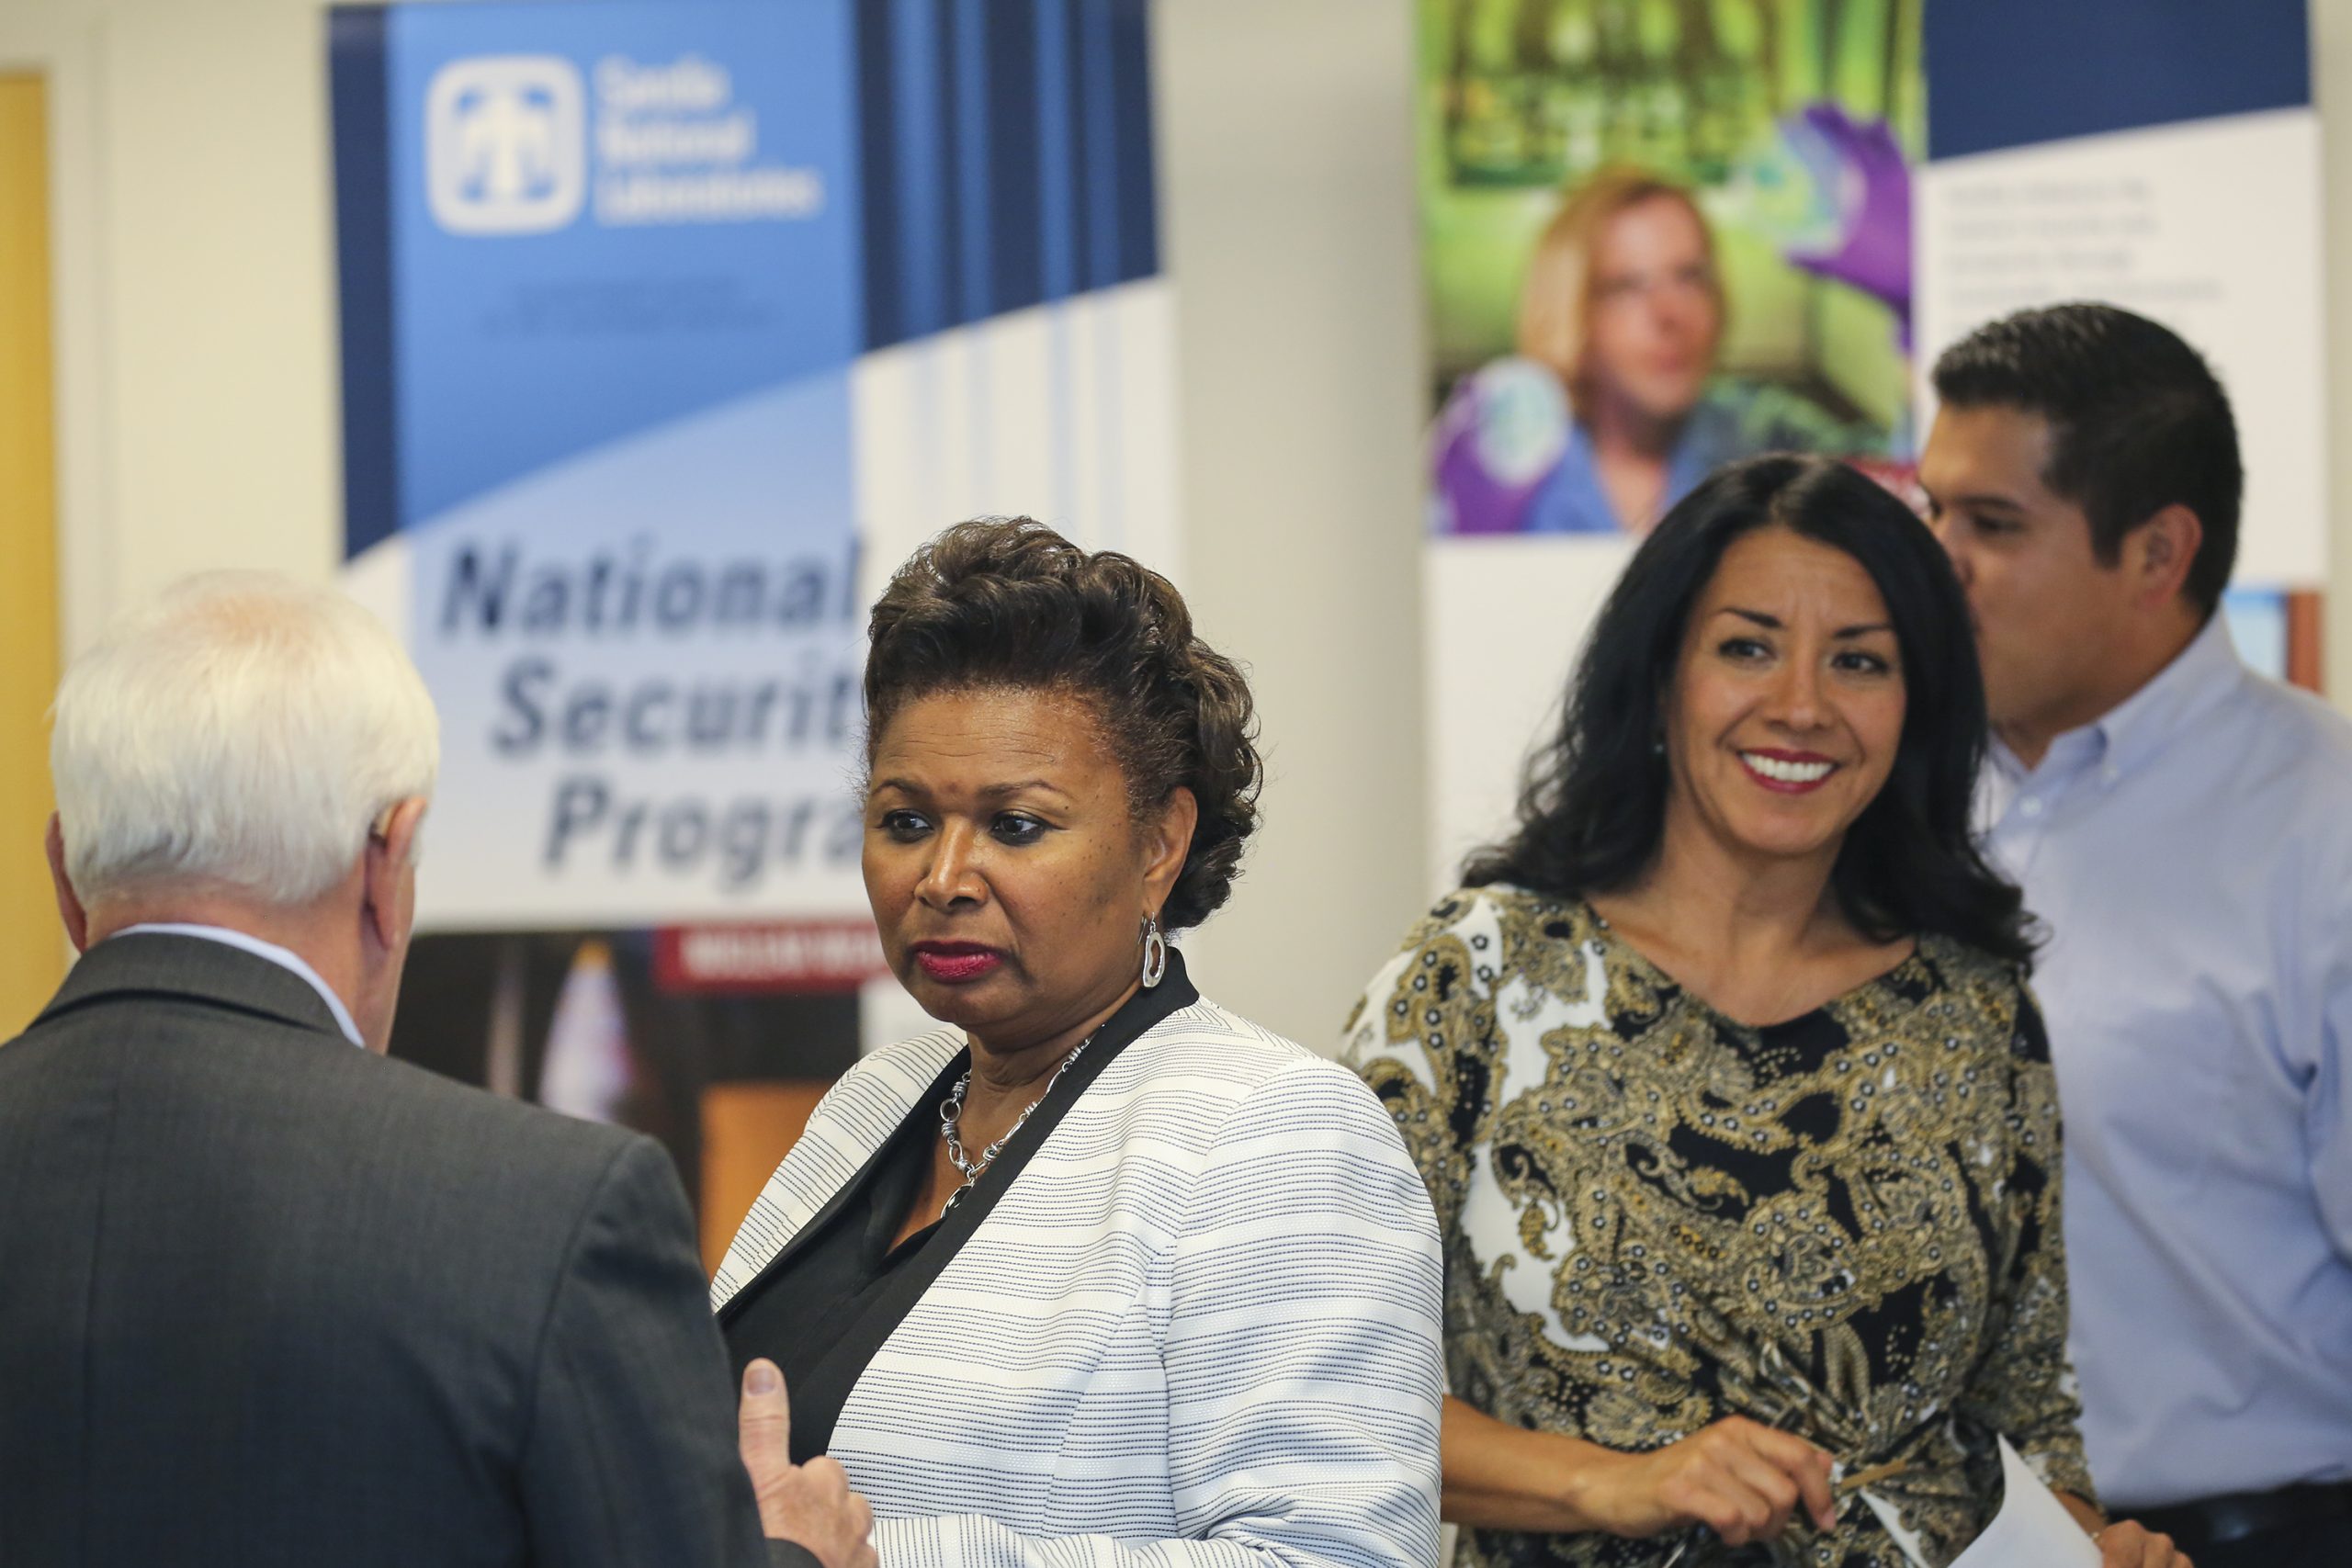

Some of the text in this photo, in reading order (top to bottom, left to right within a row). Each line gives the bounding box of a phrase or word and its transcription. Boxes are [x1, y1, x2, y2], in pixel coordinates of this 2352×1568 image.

[440, 531, 868, 636] National
[492, 654, 862, 757] Securit
[546, 775, 864, 891] Progra
